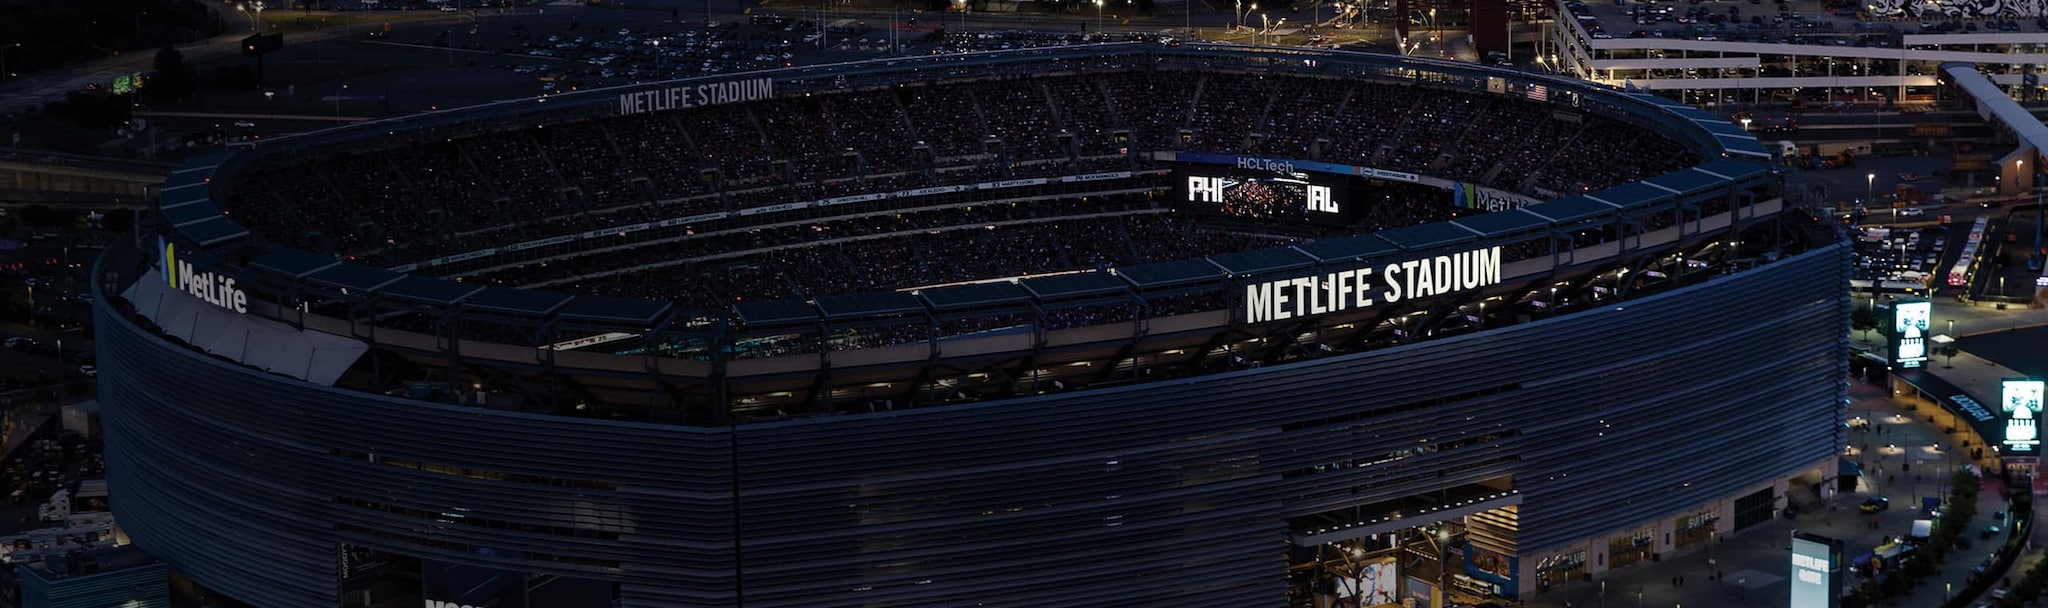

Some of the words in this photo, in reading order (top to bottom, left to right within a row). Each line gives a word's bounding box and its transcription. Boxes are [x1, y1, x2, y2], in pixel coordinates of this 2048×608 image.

[620, 86, 692, 115] METLIFE
[697, 77, 774, 106] STADIUM
[1237, 156, 1294, 173] HCLTech
[1188, 176, 1223, 203] PHI
[178, 259, 247, 314] MetLife
[1247, 266, 1373, 323] METLIFE
[1384, 246, 1501, 304] STADIUM
